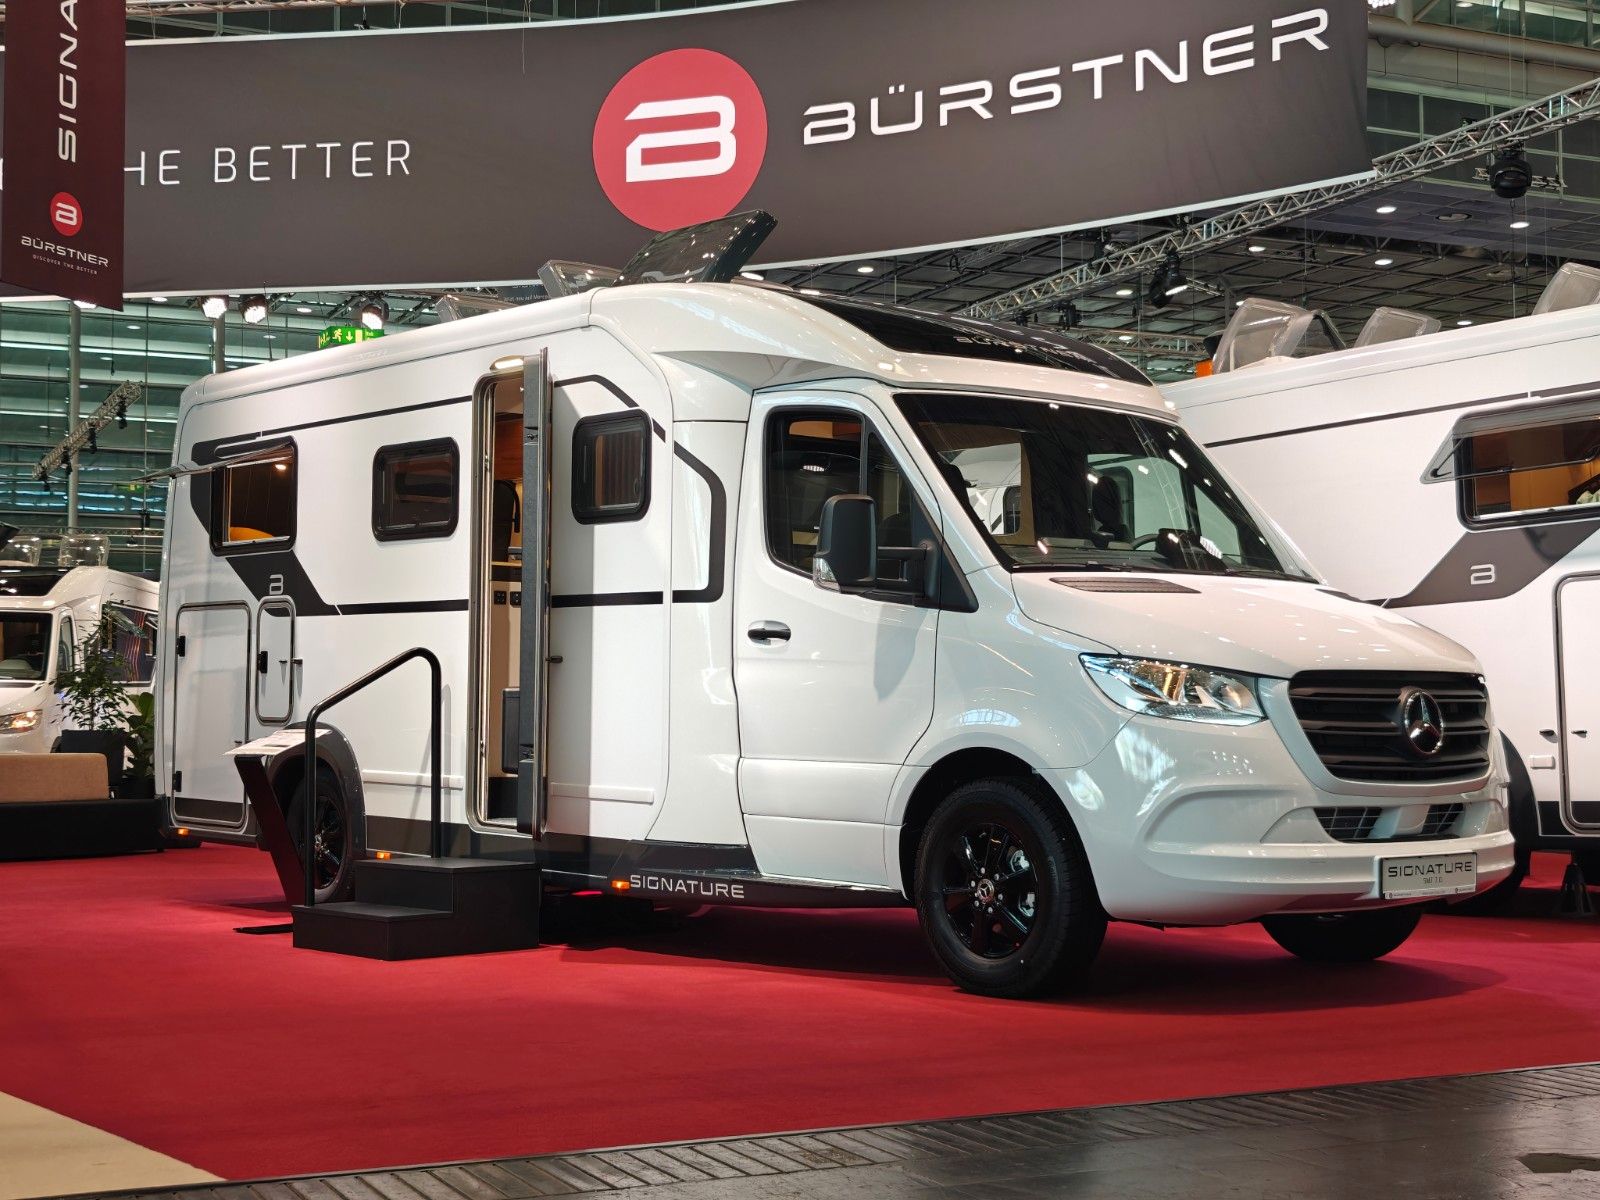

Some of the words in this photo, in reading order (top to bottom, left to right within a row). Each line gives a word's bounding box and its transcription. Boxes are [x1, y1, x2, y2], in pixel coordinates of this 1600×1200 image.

[803, 8, 1330, 146] BÜRSTNER
[123, 149, 182, 187] HE
[213, 138, 411, 184] BETTER
[20, 235, 109, 268] BÜRSTNER
[1387, 861, 1473, 878] SIGNATURE
[630, 874, 745, 899] SIGNATURE
